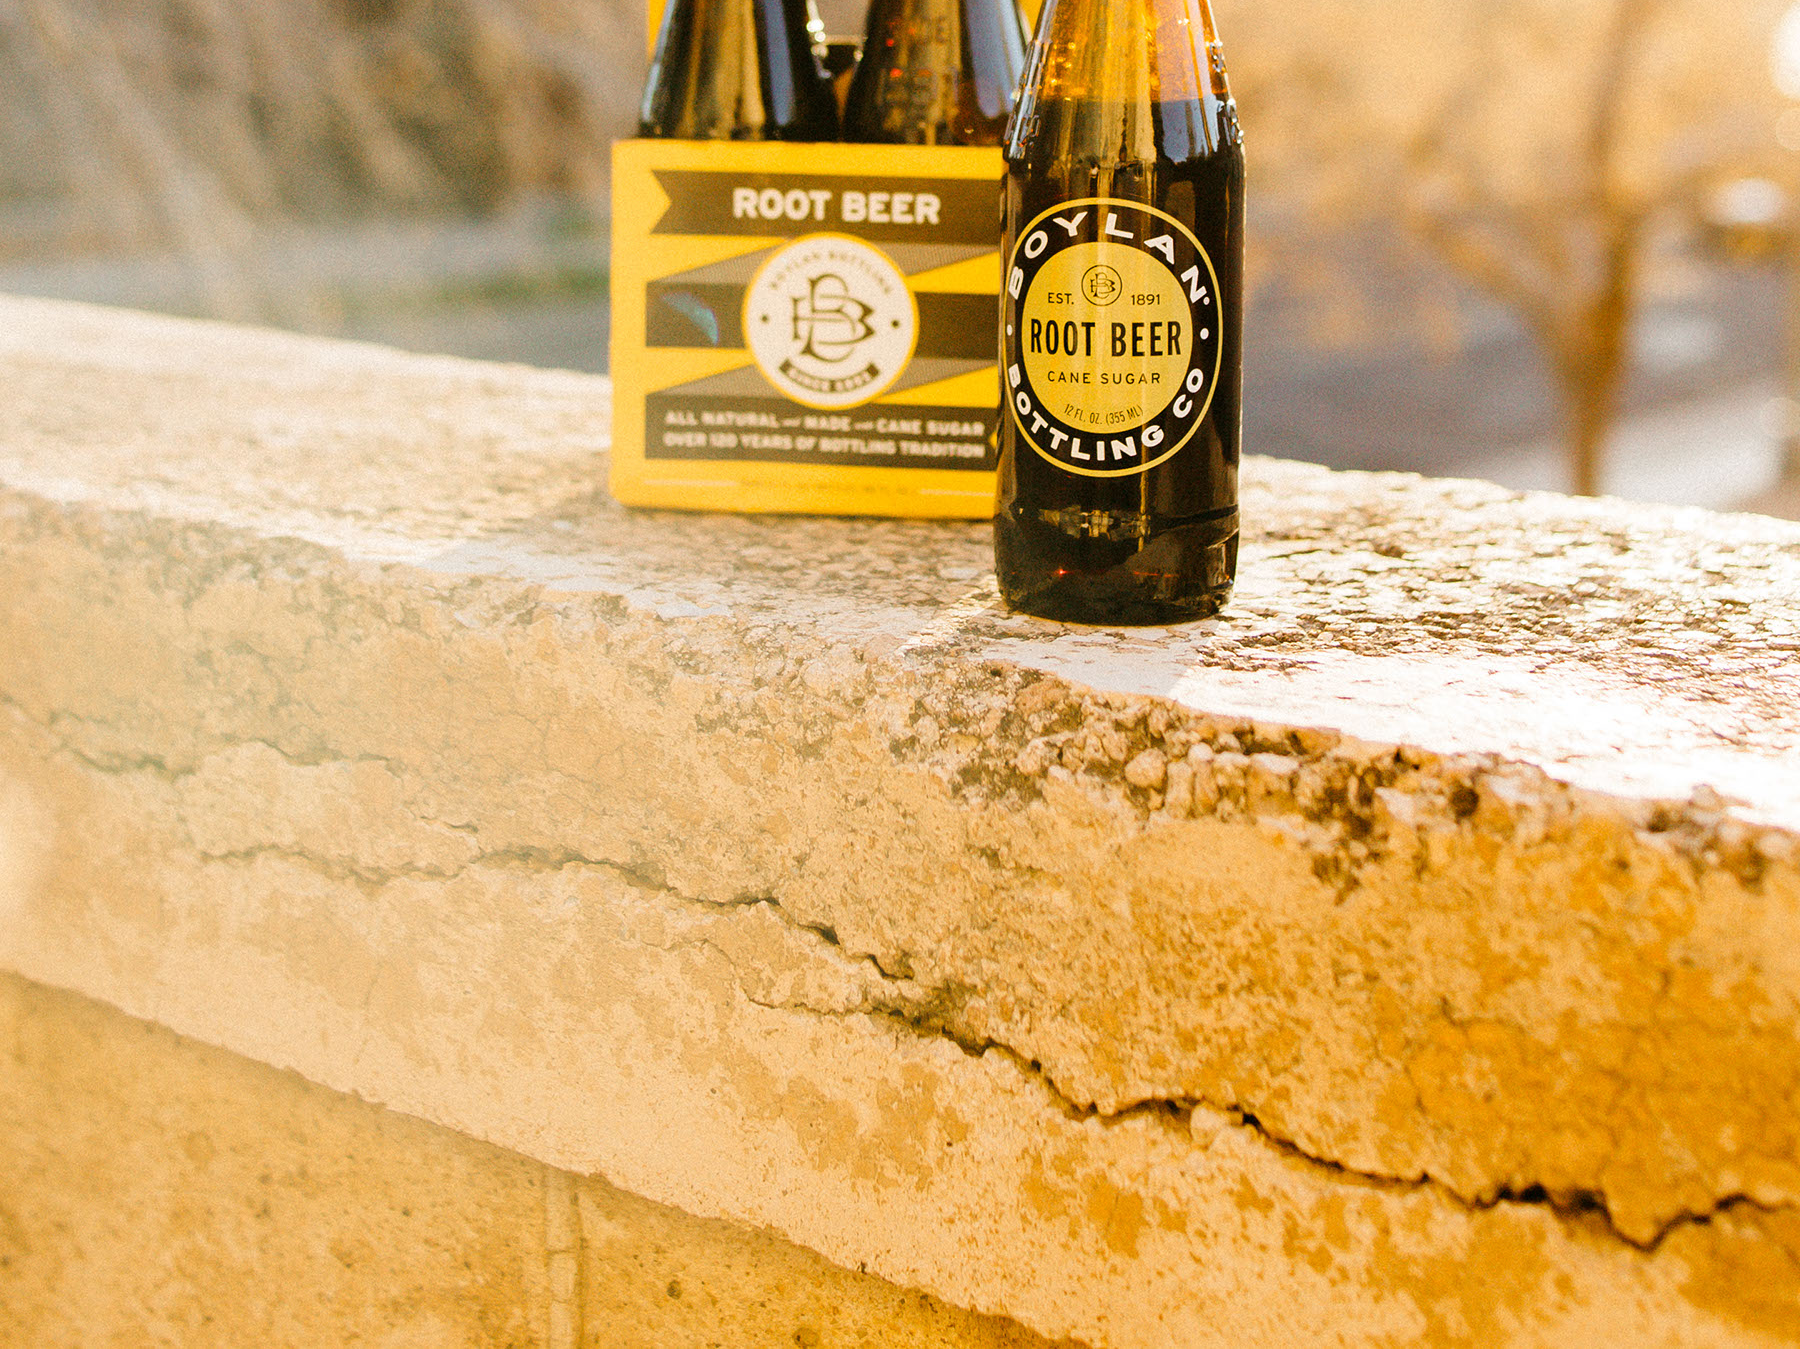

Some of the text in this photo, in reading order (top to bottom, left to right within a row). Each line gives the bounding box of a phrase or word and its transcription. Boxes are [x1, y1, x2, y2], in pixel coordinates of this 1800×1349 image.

[732, 188, 942, 225] ROOT BEER
[1047, 292, 1161, 306] EST. 1891
[1030, 318, 1182, 357] ROOT BEER
[1047, 370, 1161, 386] CANE SUGAR
[664, 410, 698, 427] ALL
[701, 411, 779, 429] NATURAL
[876, 417, 922, 435] CANE
[926, 419, 985, 437] SUGAR
[1008, 363, 1204, 461] BOTTLING CO
[1063, 403, 1145, 427] 12 FL. OZ. (355 ML)
[662, 432, 708, 448] OVER
[741, 434, 793, 450] YEARS
[900, 440, 986, 459] TRADITION
